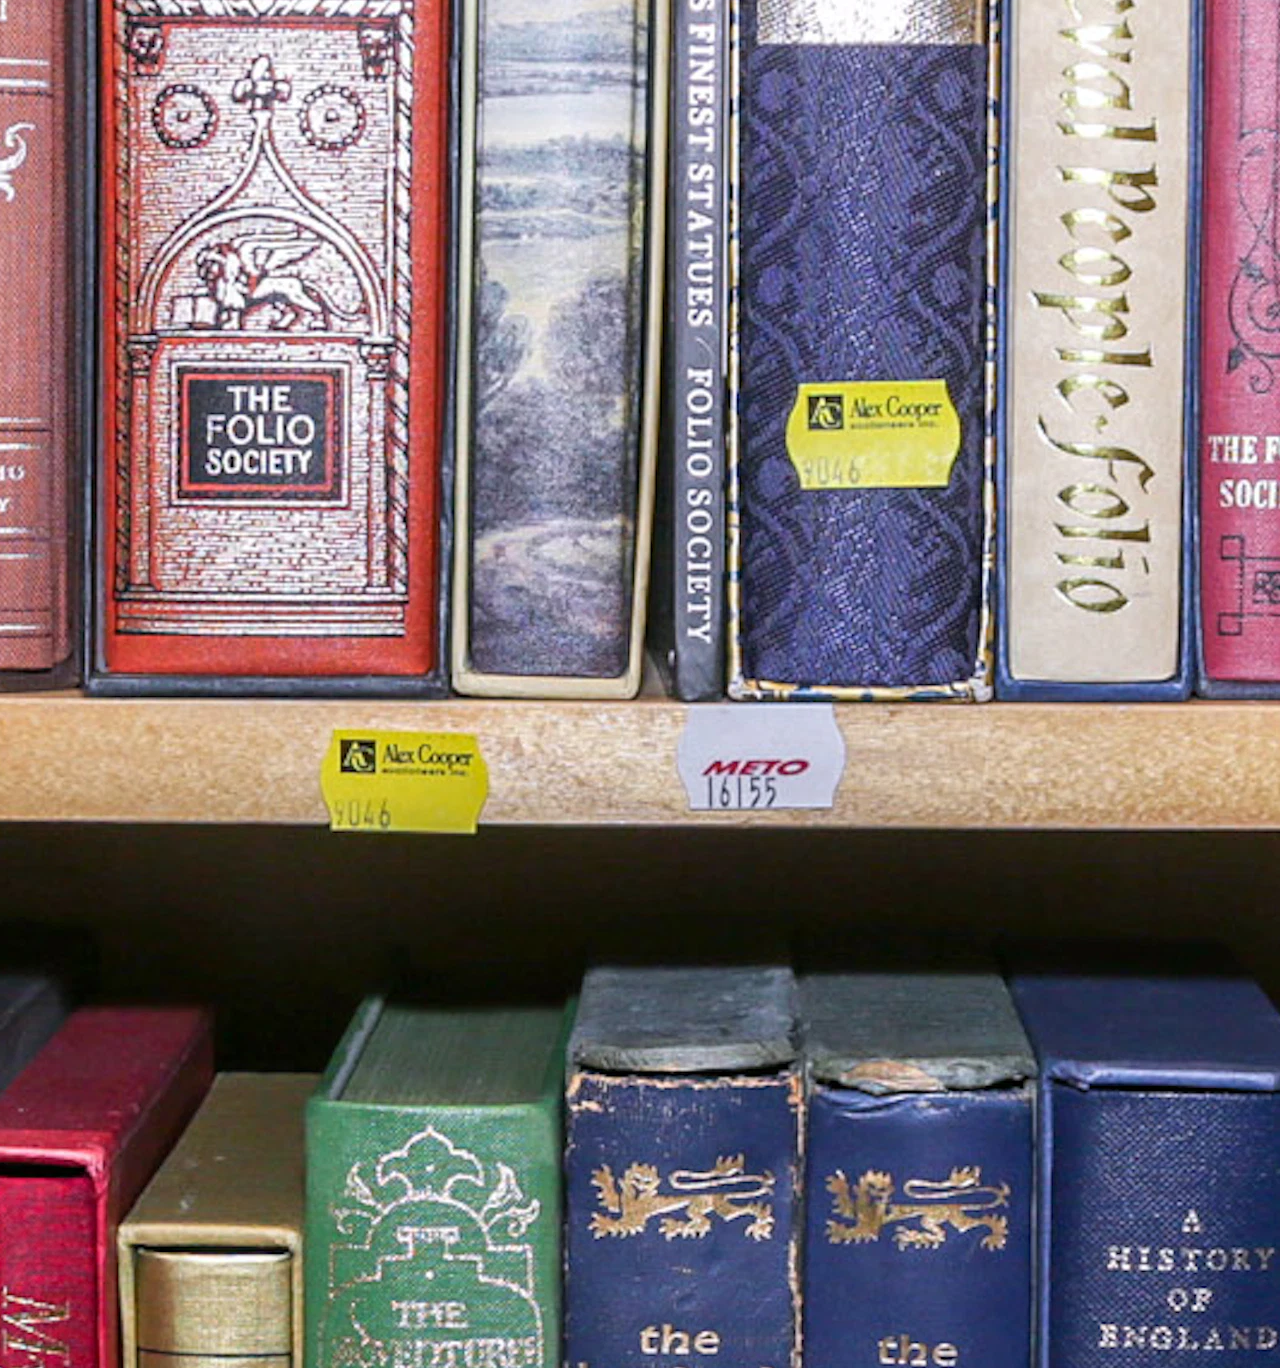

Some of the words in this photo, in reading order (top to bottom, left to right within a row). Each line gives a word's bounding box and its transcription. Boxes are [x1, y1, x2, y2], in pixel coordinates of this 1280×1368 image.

[688, 23, 717, 152] FINEST
[687, 163, 715, 327] STATUES
[227, 386, 293, 412] THE
[851, 398, 882, 418] Alex
[886, 396, 942, 421] Cooper
[206, 414, 315, 445] FOLIO
[687, 368, 713, 478] FOLIO
[205, 449, 313, 475] SOCIETY
[1208, 435, 1258, 464] THE
[686, 490, 712, 646] SOCIETY
[382, 744, 416, 764] Alex
[418, 744, 474, 767] Cooper
[702, 760, 810, 775] METO
[708, 777, 777, 806] 16155
[1183, 1209, 1200, 1232] A
[1106, 1245, 1276, 1272] HISTORY
[1166, 1288, 1213, 1311] OF
[393, 1301, 469, 1329] THE
[640, 1324, 719, 1355] the
[878, 1335, 958, 1366] the
[1099, 1324, 1278, 1351] ENGLAND
